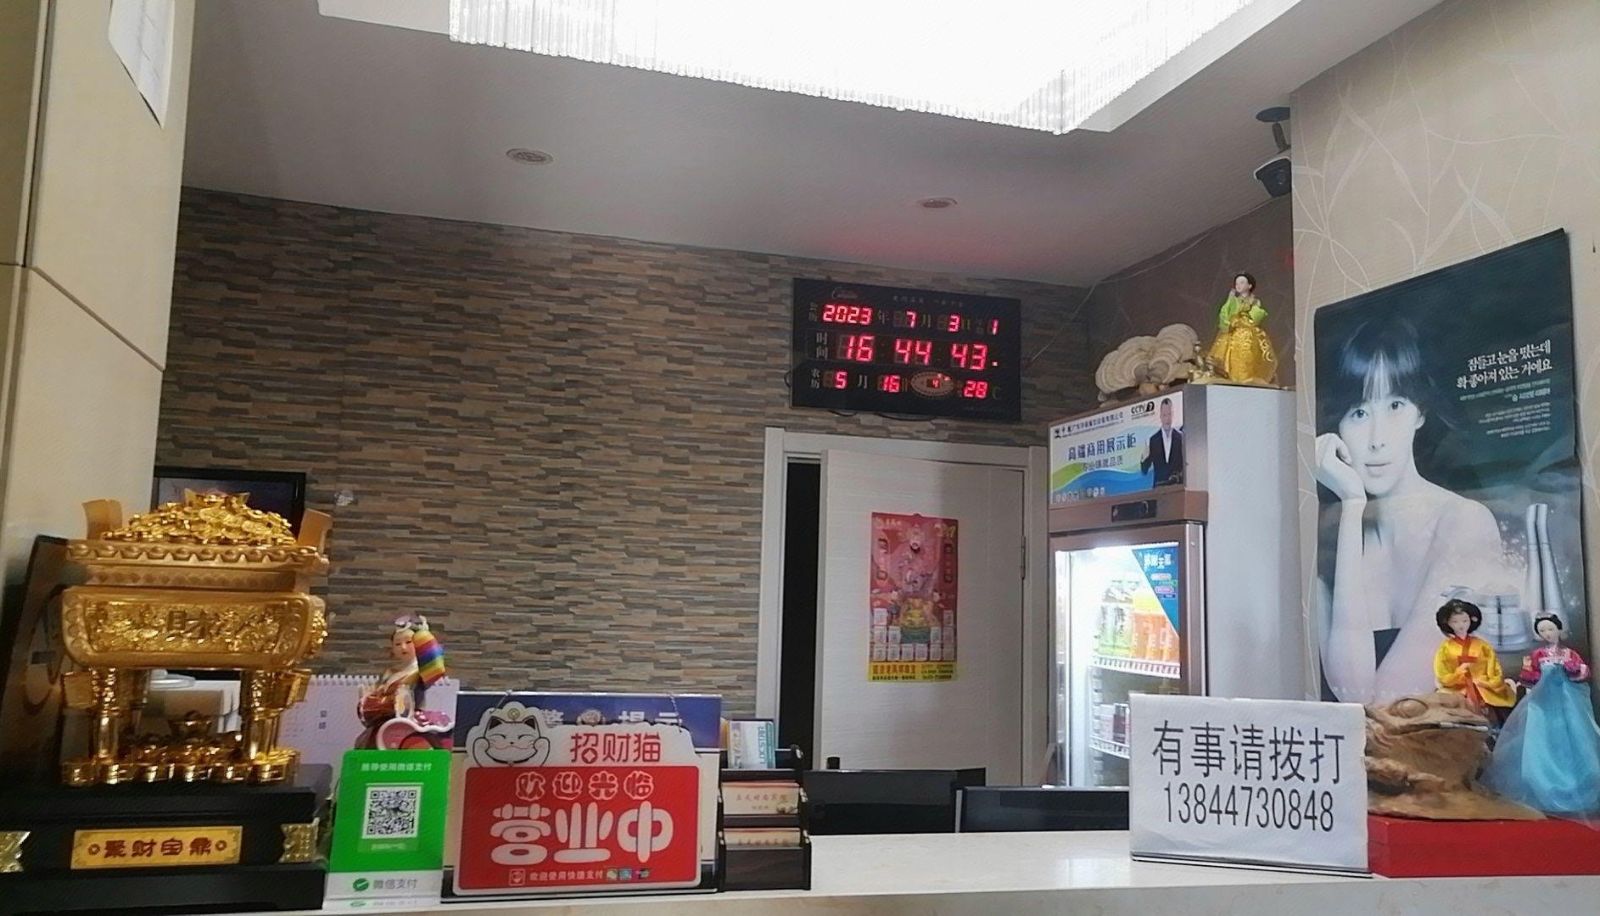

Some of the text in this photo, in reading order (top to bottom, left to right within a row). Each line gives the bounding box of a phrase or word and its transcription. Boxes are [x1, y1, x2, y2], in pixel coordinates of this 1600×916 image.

[822, 304, 873, 325] 2023
[905, 311, 917, 328] 7
[948, 315, 961, 332] 3
[816, 332, 988, 371] 时间 16 44 43
[833, 371, 848, 389] 5
[881, 375, 900, 393] 16
[963, 380, 988, 399] 28
[1498, 365, 1520, 381] 있는
[1068, 432, 1137, 462] 高端商用展示柜
[570, 731, 661, 765] 招财猫
[1152, 720, 1345, 785] 有事请拨打
[515, 770, 654, 801] 欢迎光临
[1164, 781, 1334, 832] 13844730848
[490, 800, 674, 865] 营业中
[373, 879, 418, 890] 微信支付
